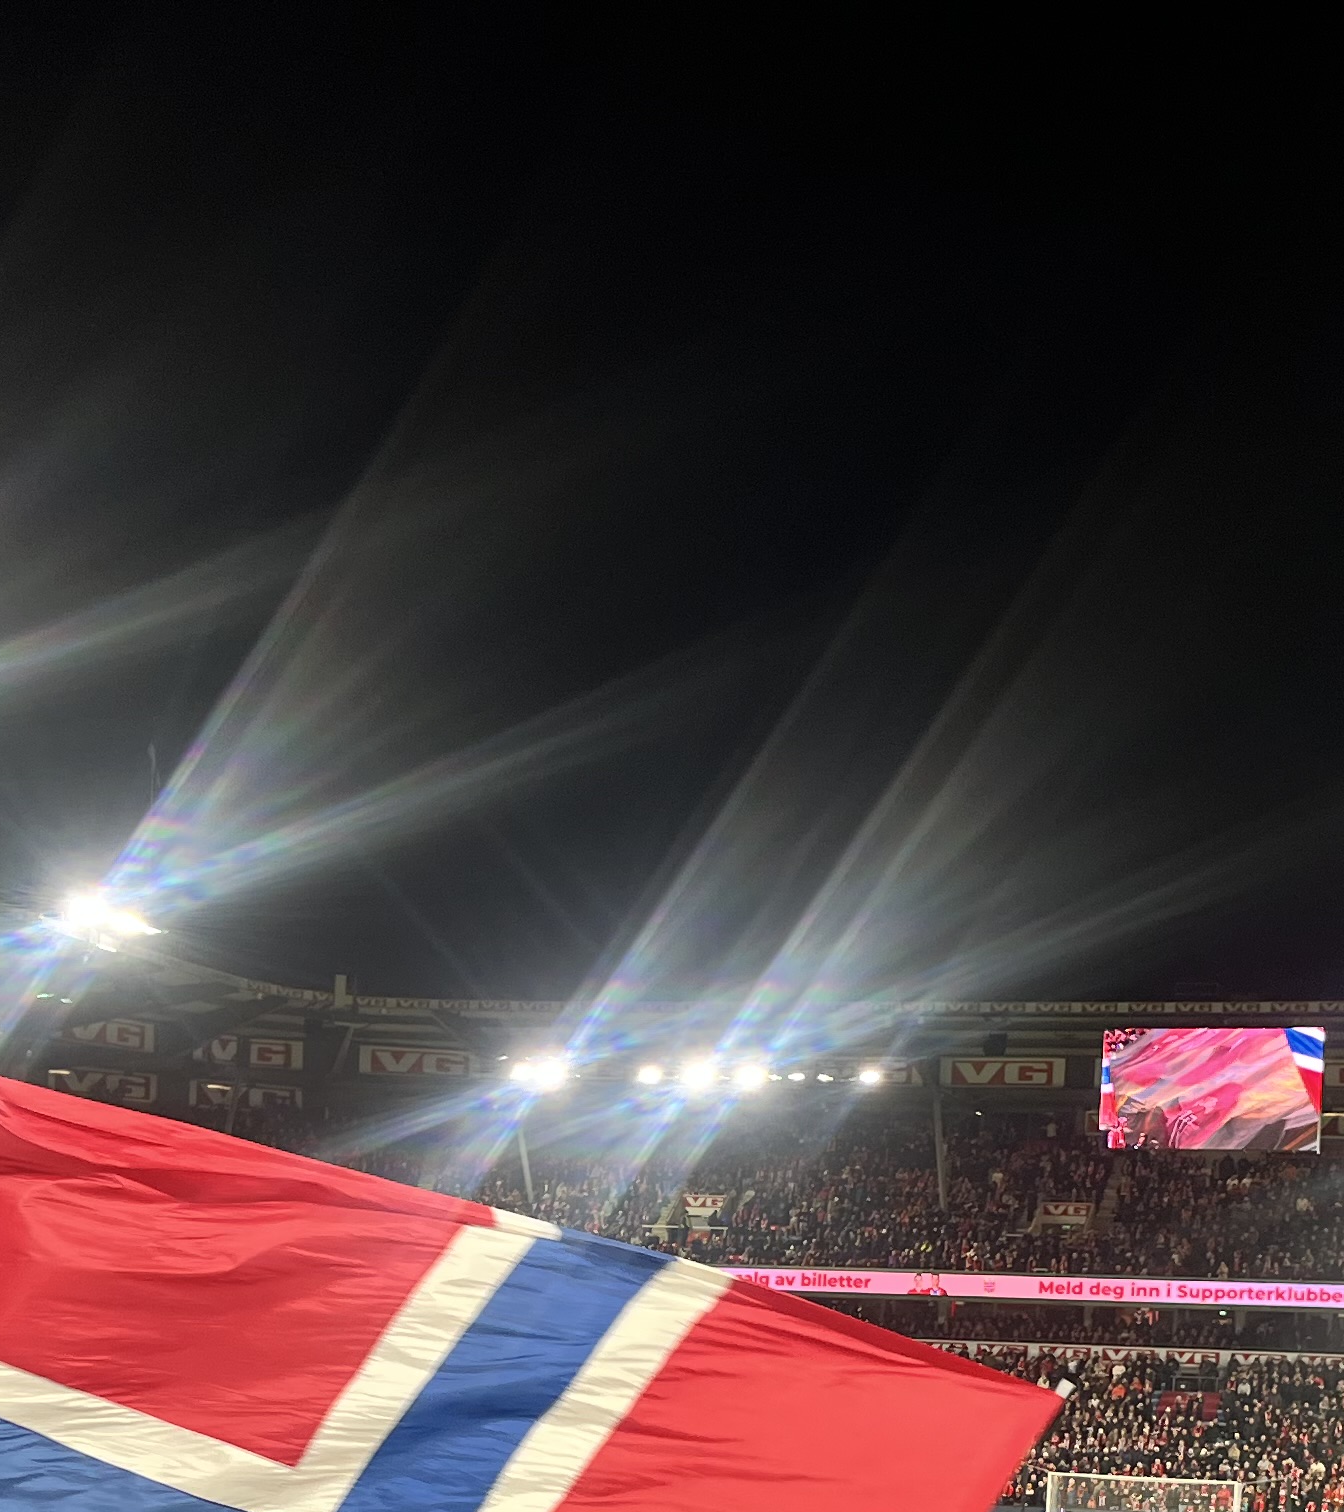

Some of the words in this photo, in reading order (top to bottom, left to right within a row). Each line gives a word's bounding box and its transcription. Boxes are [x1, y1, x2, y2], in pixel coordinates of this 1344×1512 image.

[374, 1050, 468, 1074] VG
[954, 1061, 1053, 1084] VG
[685, 1196, 724, 1208] VG
[1045, 1204, 1089, 1216] VG
[774, 1277, 796, 1288] av
[800, 1272, 871, 1289] billetter
[1038, 1281, 1083, 1296] Meld
[1089, 1282, 1124, 1300] deg
[1131, 1282, 1160, 1298] inn
[1166, 1283, 1171, 1298] i
